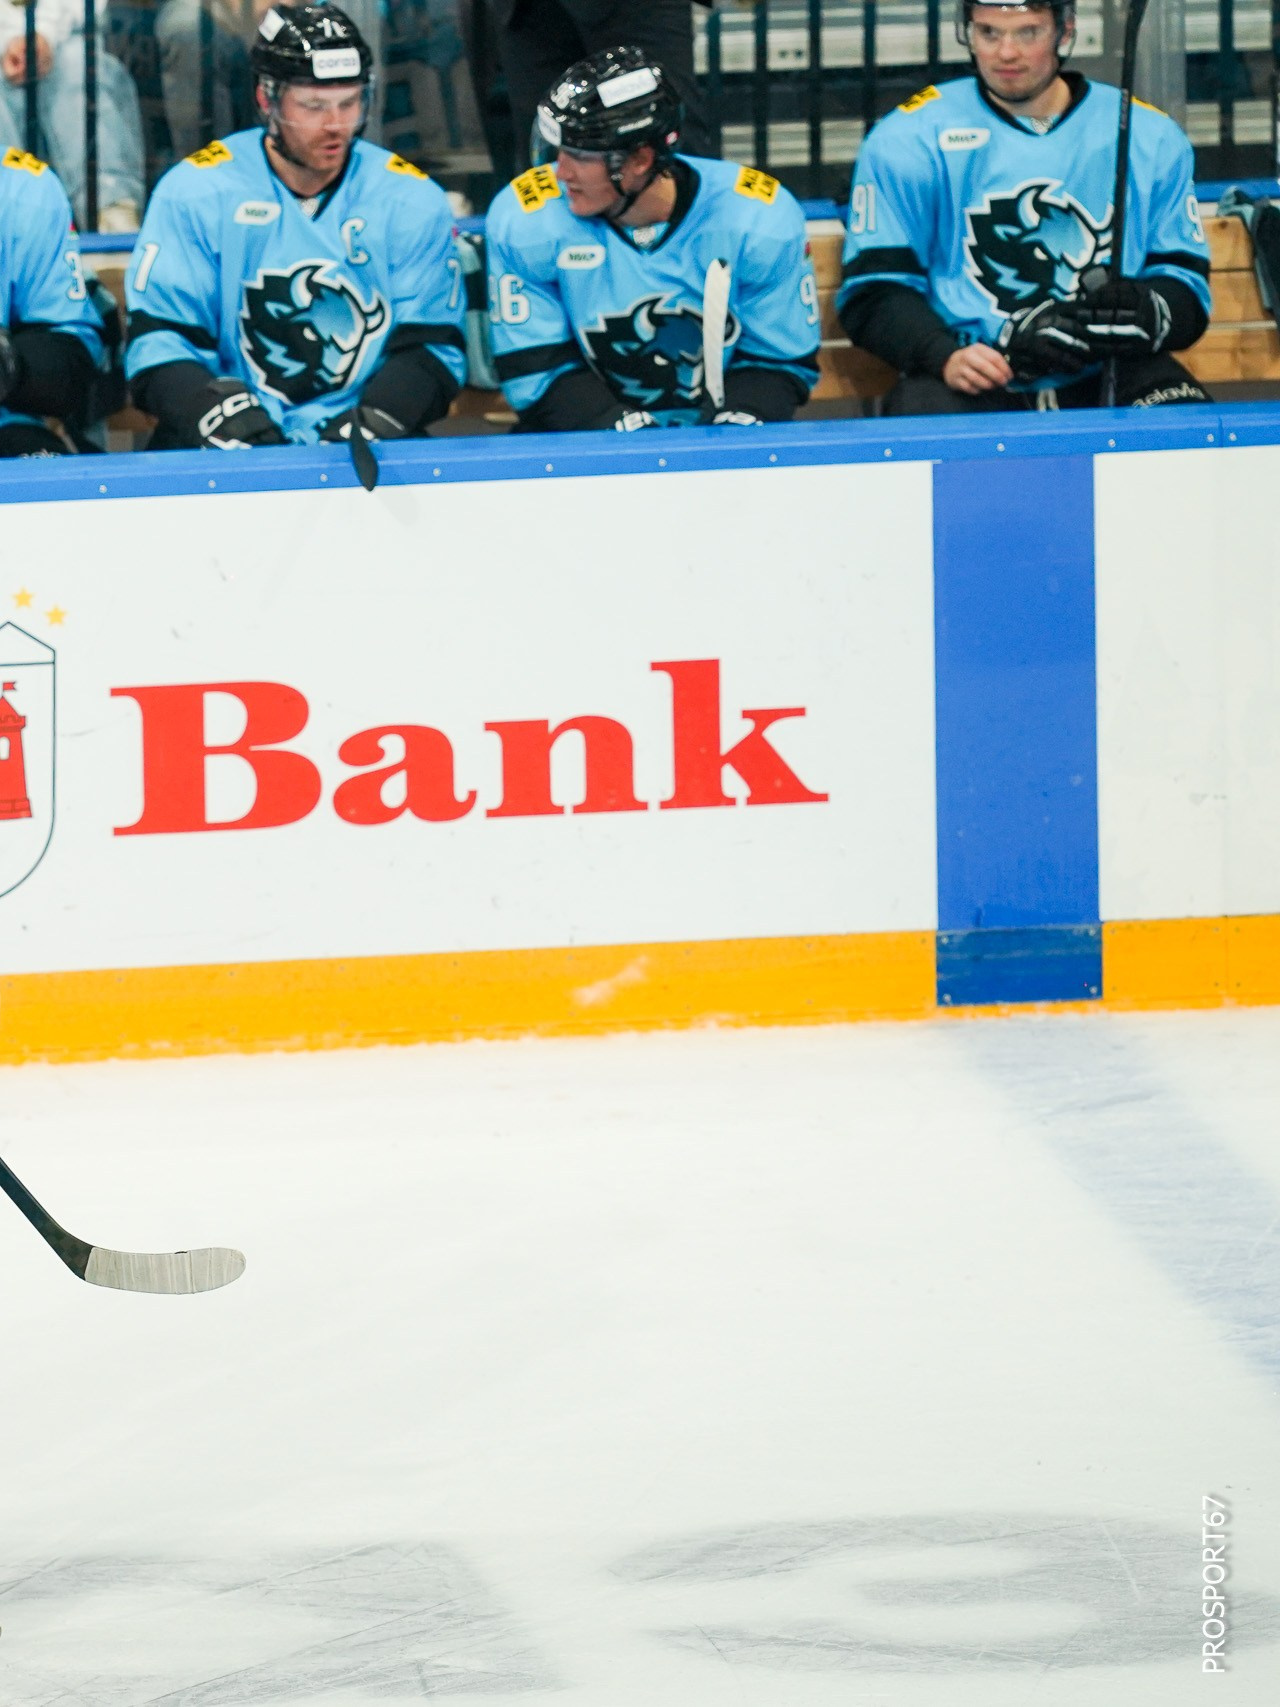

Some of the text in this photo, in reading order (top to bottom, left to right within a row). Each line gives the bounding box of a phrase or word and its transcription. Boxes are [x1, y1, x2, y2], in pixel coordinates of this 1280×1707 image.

[850, 183, 877, 234] 91
[340, 217, 370, 266] C
[109, 658, 829, 836] Bank
